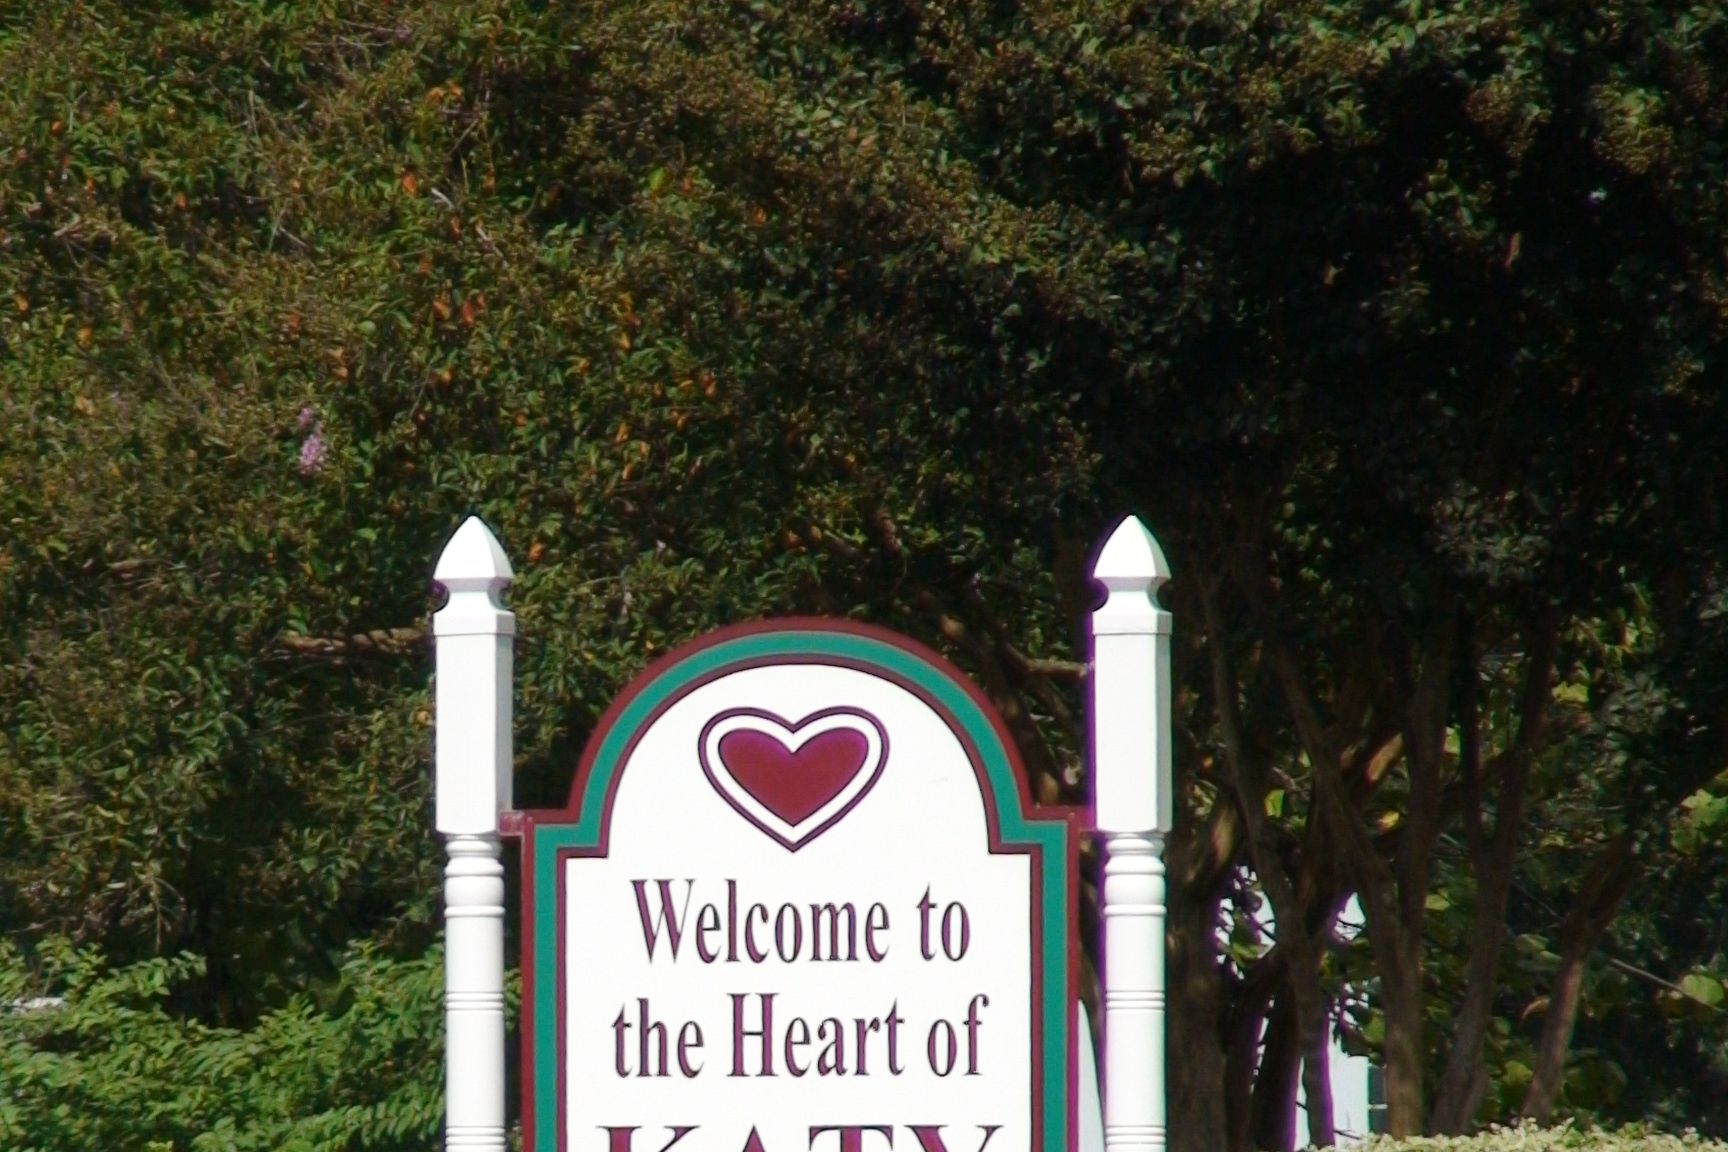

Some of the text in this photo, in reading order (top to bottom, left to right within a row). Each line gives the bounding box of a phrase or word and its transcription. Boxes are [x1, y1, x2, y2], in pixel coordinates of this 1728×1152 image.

[632, 879, 970, 964] Welcome to
[611, 993, 989, 1078] the Heart of
